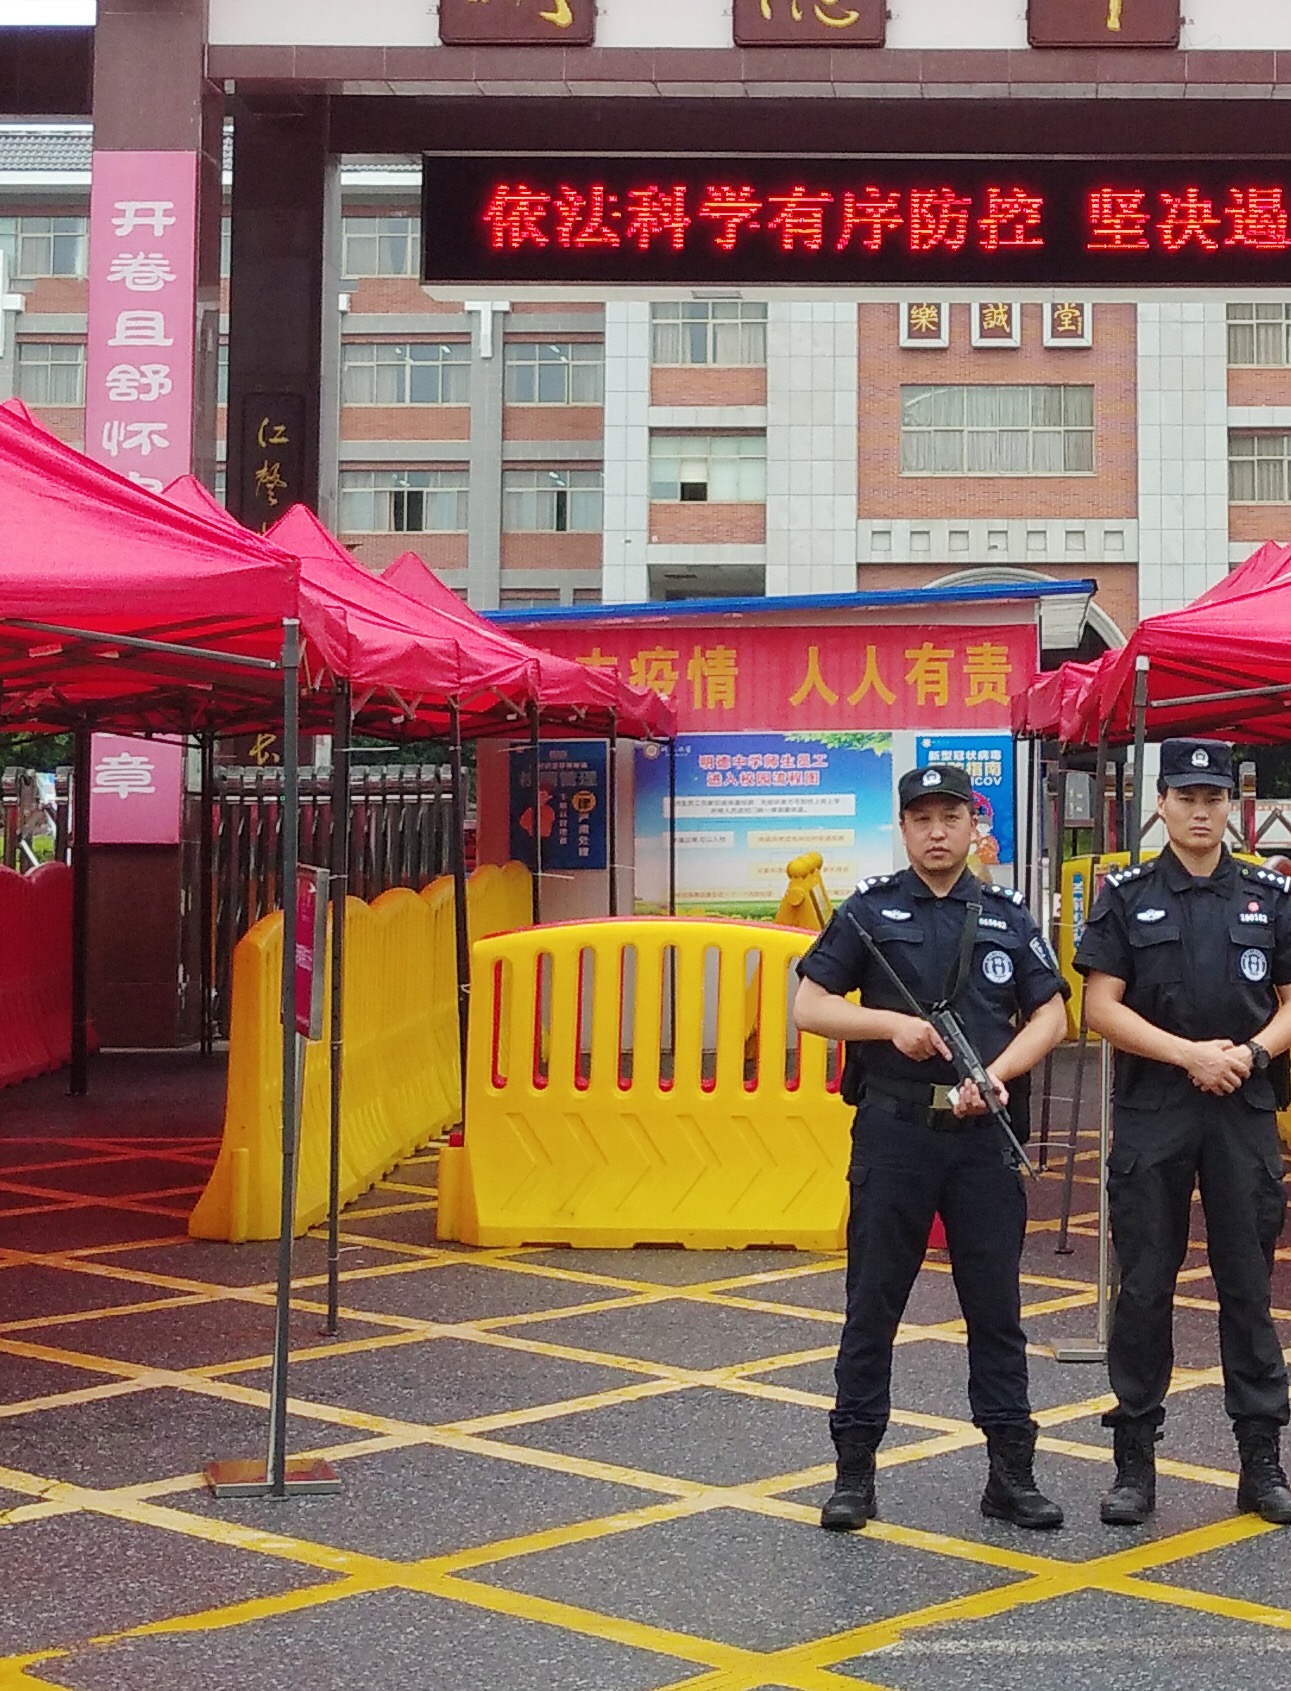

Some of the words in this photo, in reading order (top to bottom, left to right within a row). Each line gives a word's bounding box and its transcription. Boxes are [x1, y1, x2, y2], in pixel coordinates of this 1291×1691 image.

[482, 184, 1044, 251] 依法科学有序防控
[790, 642, 1013, 708] 人人有责
[699, 753, 829, 770] 明德中学师生员工
[927, 749, 1002, 761] 新型冠状病毒
[91, 752, 155, 799] 章
[706, 771, 821, 787] 进入校园流程图
